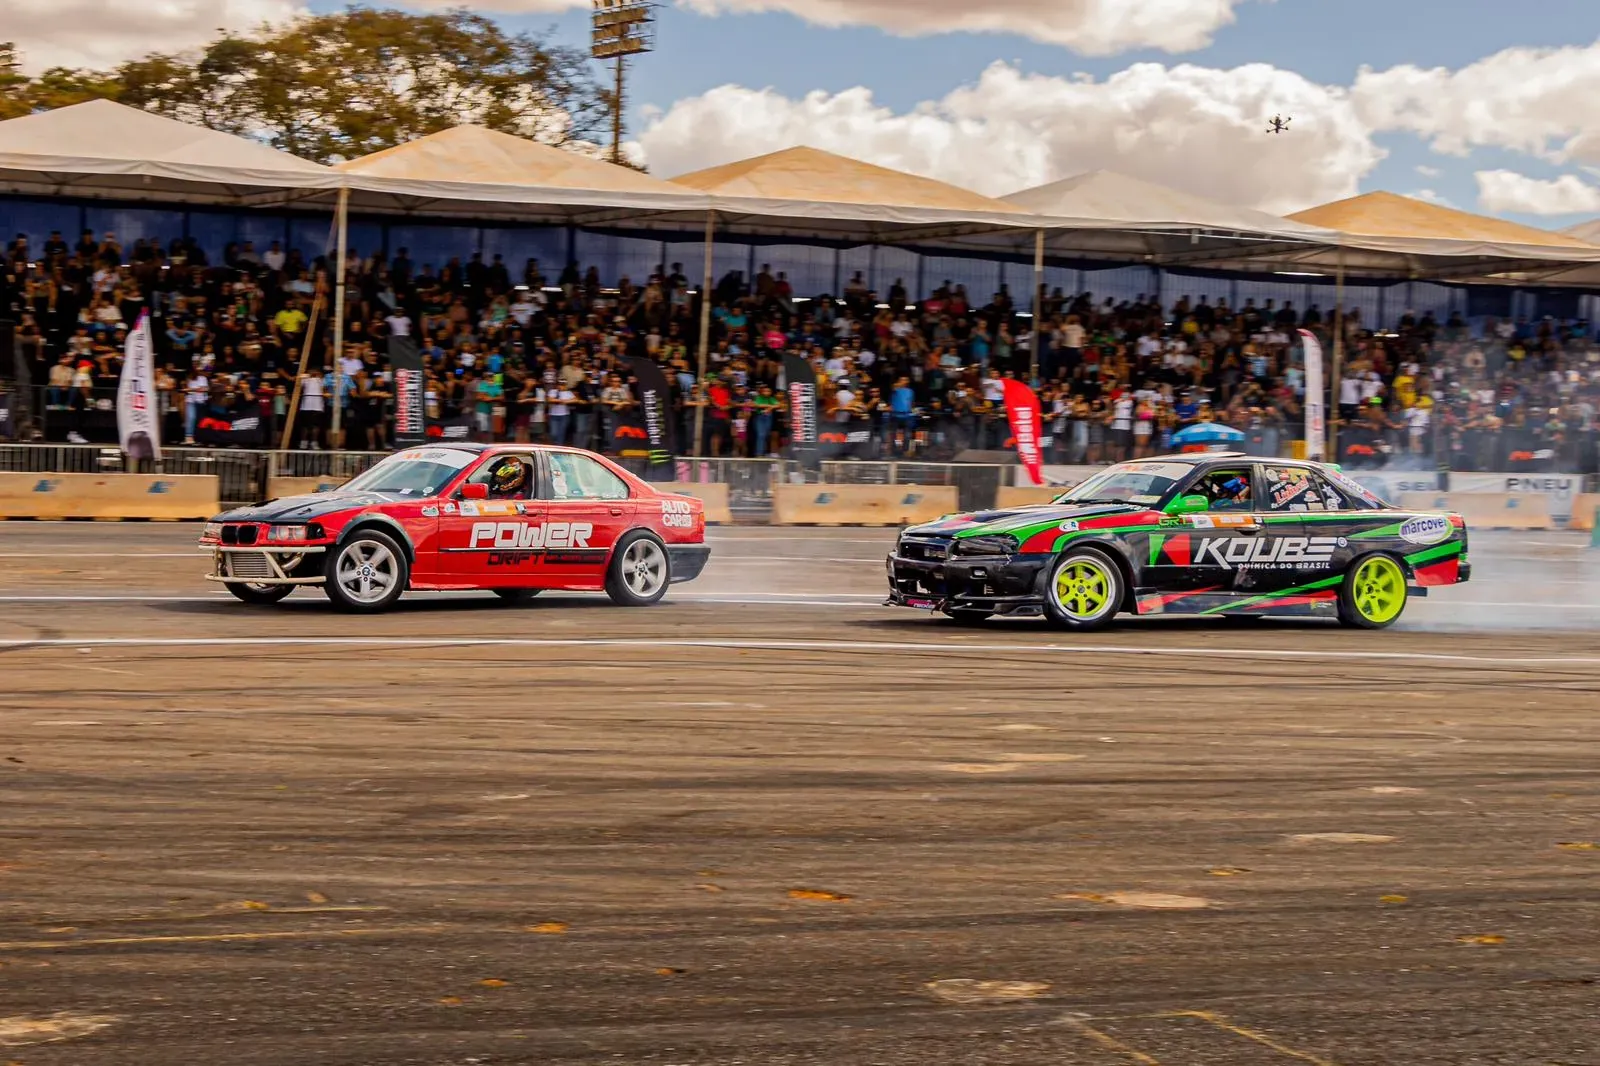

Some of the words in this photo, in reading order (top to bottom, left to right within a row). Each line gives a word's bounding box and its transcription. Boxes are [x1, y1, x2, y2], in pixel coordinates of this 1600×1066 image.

[1506, 478, 1572, 490] PNEU
[662, 500, 691, 514] AUTO
[469, 522, 593, 548] POWER
[487, 552, 544, 566] DRIFT
[1194, 537, 1338, 570] KOUBE
